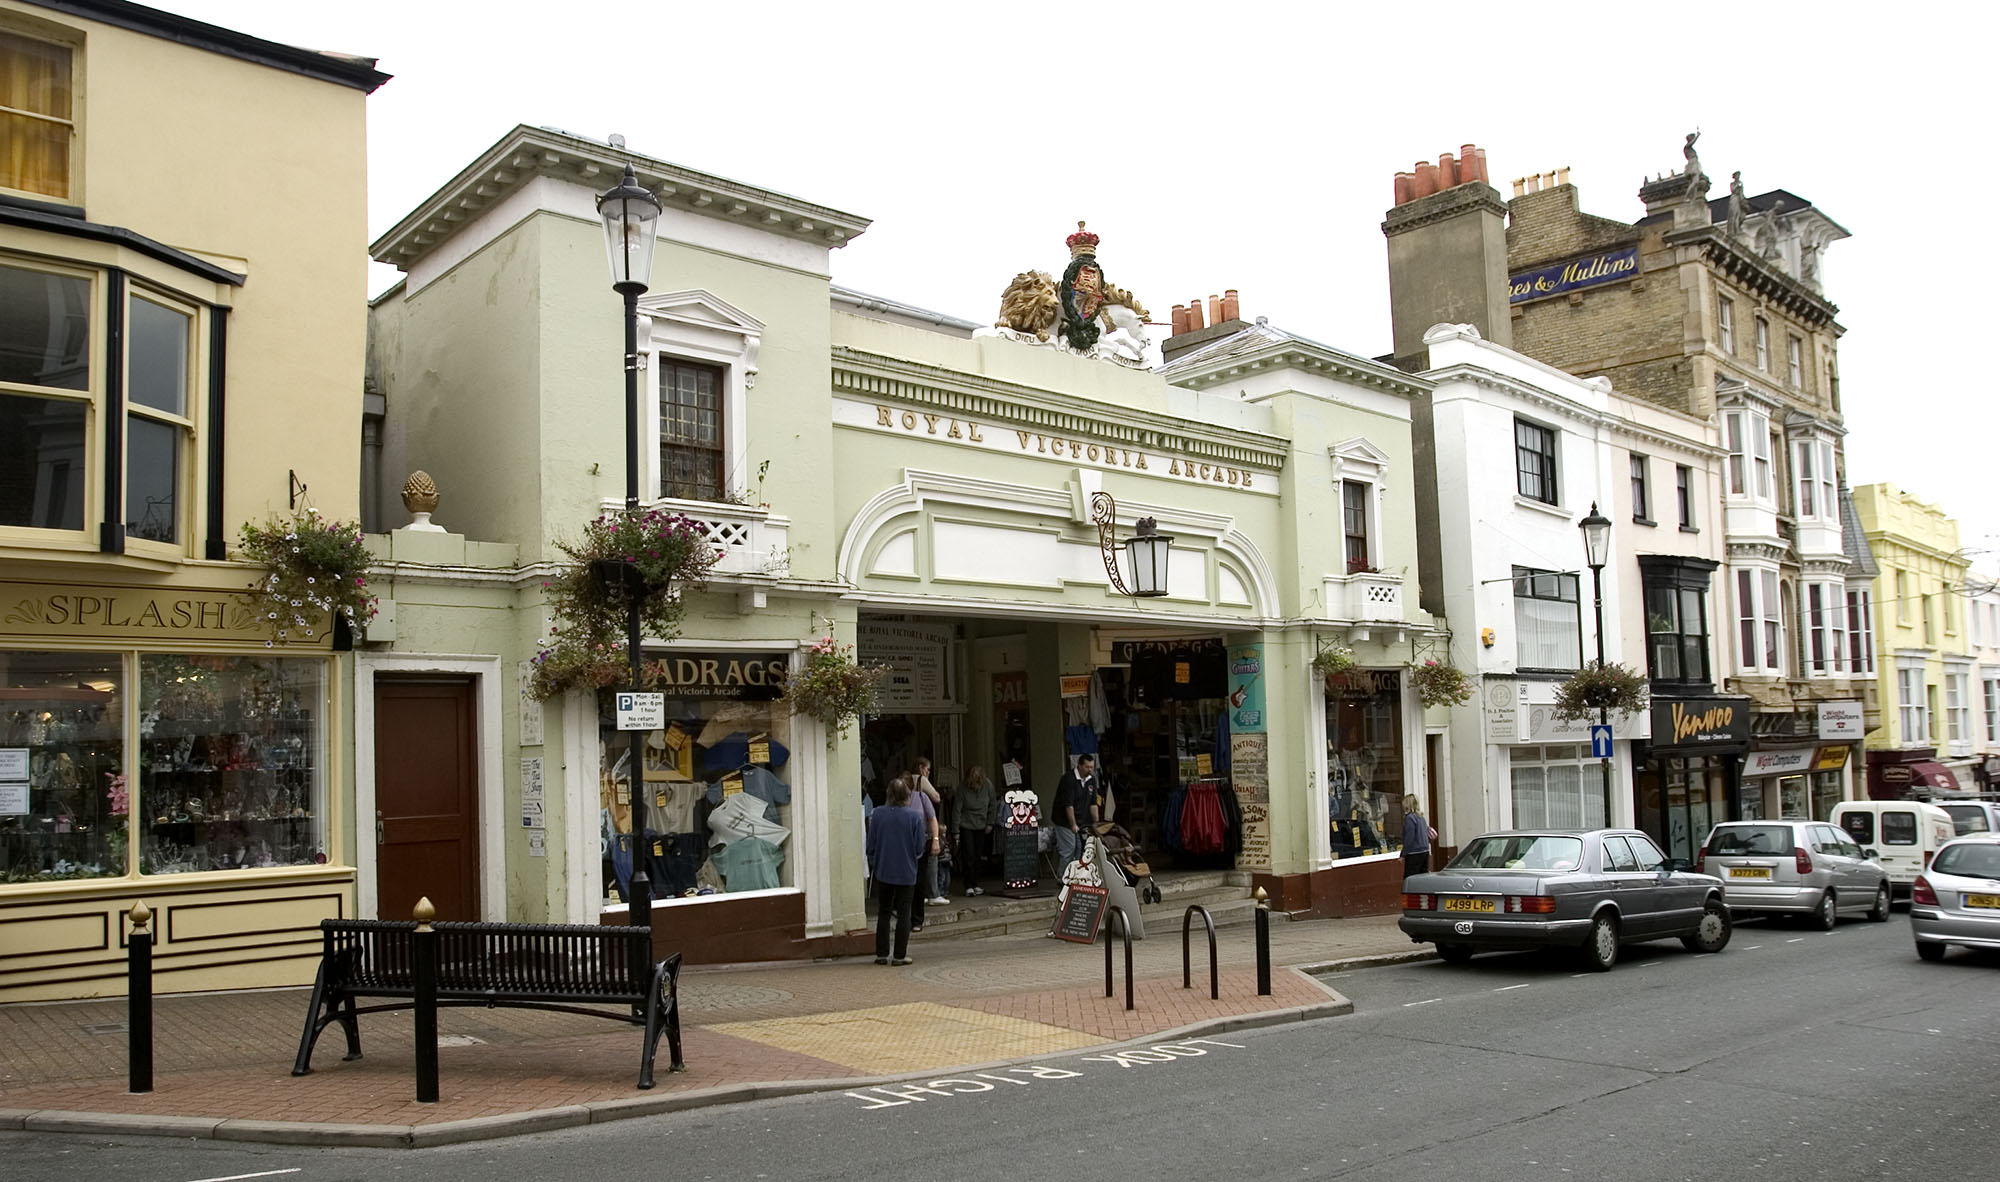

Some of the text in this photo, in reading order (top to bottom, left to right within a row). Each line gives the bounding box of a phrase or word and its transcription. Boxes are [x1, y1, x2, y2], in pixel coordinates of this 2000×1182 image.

[1508, 255, 1635, 297] hes & Mullins
[1015, 332, 1035, 344] DIEU
[876, 405, 1253, 487] ROYAL VICTORIA ARCADE
[45, 594, 228, 630] SPLASH
[892, 628, 922, 640] VICTORIA
[926, 633, 949, 645] ARCADE
[1122, 641, 1213, 662] GDRG
[643, 657, 787, 687] ADRAGS
[1232, 661, 1260, 675] GUITARS
[678, 687, 711, 696] Victoria
[713, 688, 742, 696] Arcade
[993, 681, 1027, 703] SAL
[621, 697, 631, 710] P
[1756, 753, 1802, 770] Wight Computers
[530, 781, 543, 795] Shop
[1446, 899, 1494, 910] J499 LRP
[1456, 923, 1471, 933] GB
[1082, 1038, 1246, 1068] LOOK
[844, 1065, 1084, 1110] RIGHT
